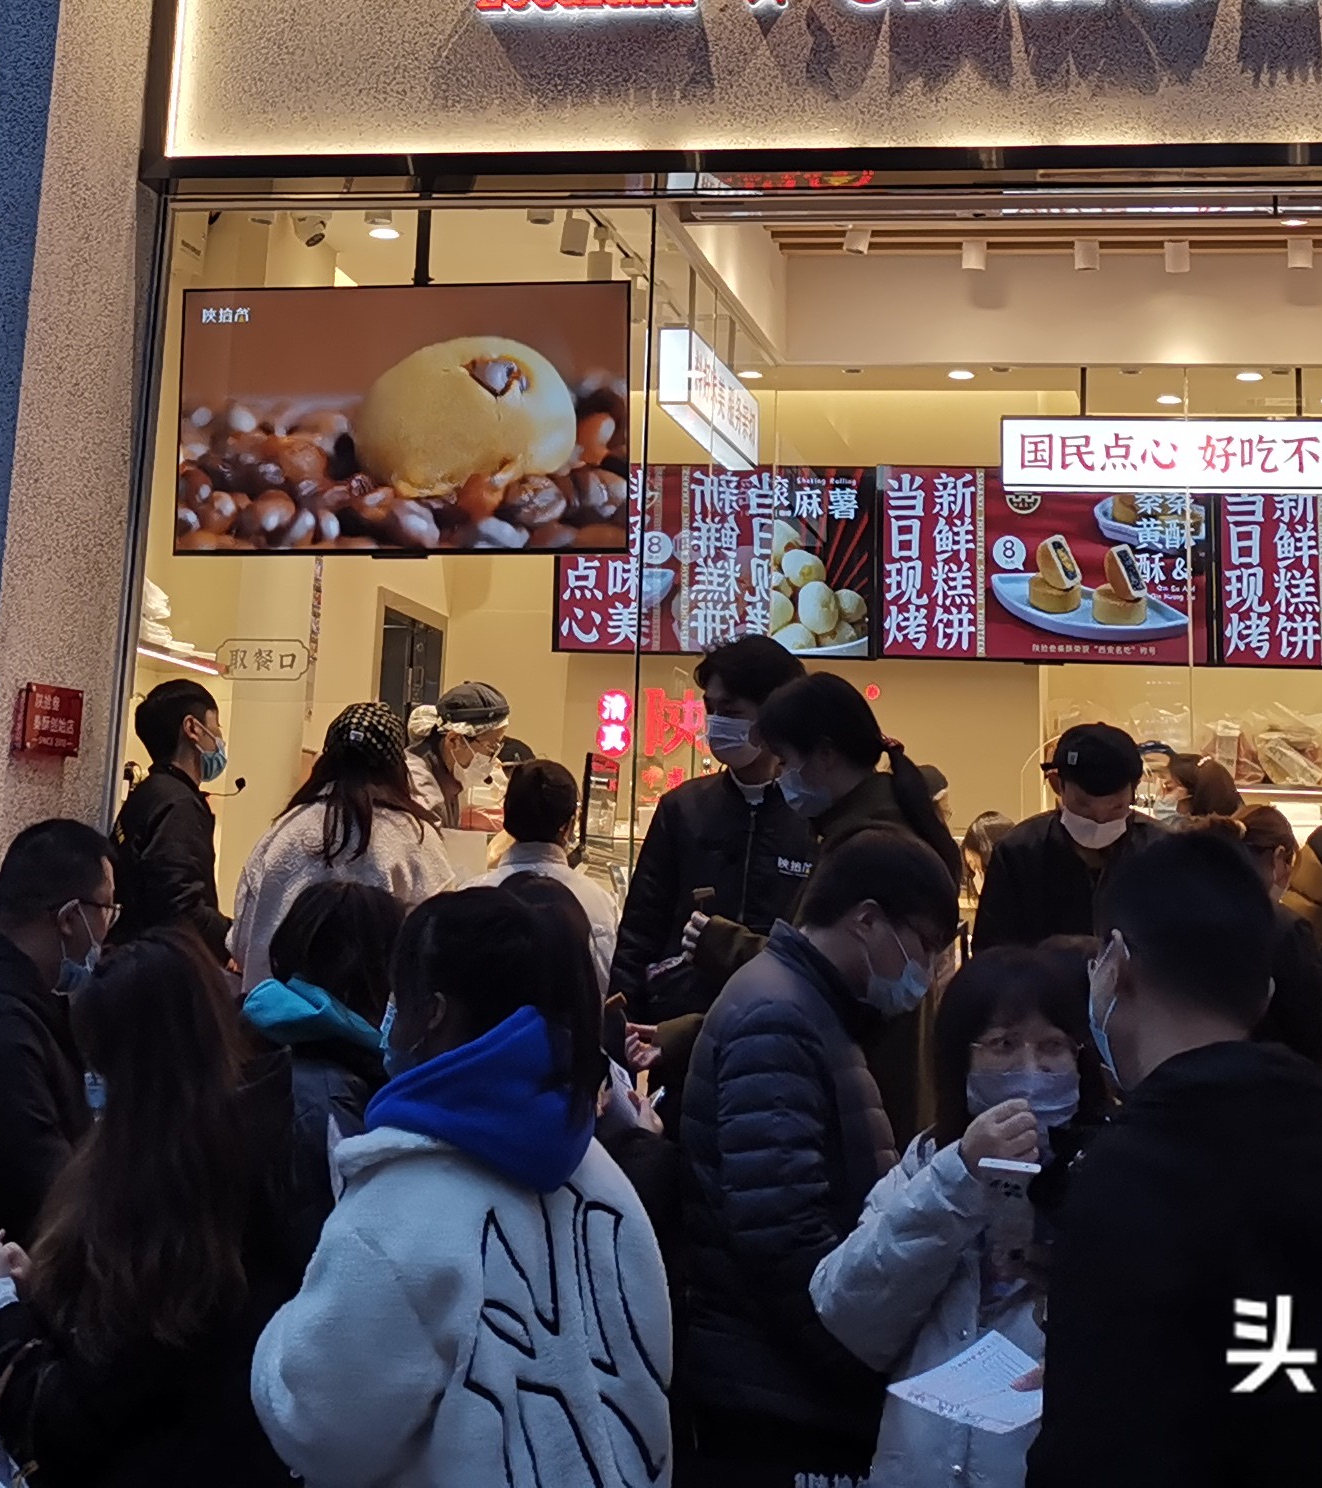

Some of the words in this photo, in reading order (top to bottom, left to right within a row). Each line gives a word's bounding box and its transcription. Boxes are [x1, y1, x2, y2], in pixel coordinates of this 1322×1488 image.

[1018, 432, 1179, 473] 国民点心
[647, 536, 661, 554] 8
[883, 472, 929, 651] 当日现烤
[932, 472, 977, 652] 新鲜糕饼
[1002, 539, 1016, 559] 8
[1224, 495, 1271, 659] 当日现烤
[1274, 495, 1322, 660] 新鲜糕饼
[228, 647, 297, 672] 取餐口
